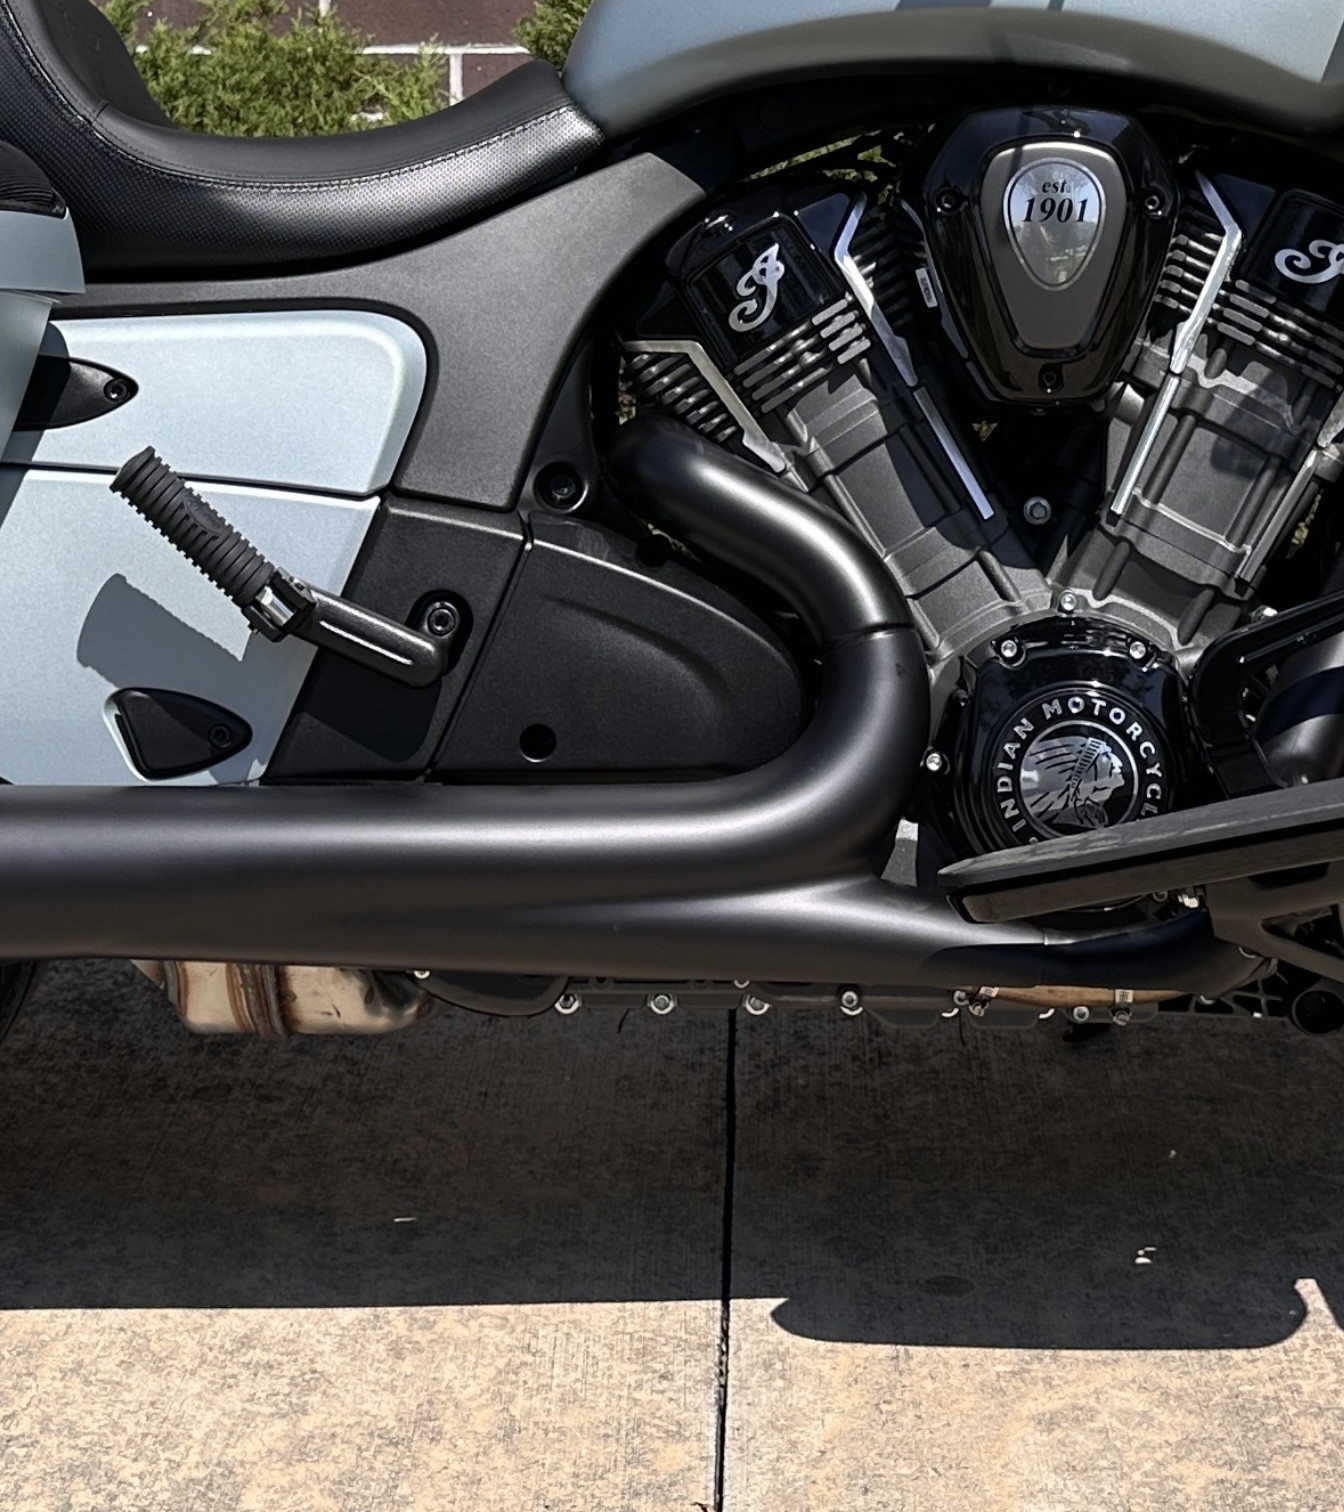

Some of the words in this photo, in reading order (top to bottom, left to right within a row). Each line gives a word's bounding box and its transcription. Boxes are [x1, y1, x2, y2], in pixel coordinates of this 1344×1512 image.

[1021, 197, 1088, 223] 1901
[996, 717, 1035, 833] INDIAN
[1042, 696, 1163, 820] MOTORCYCL
